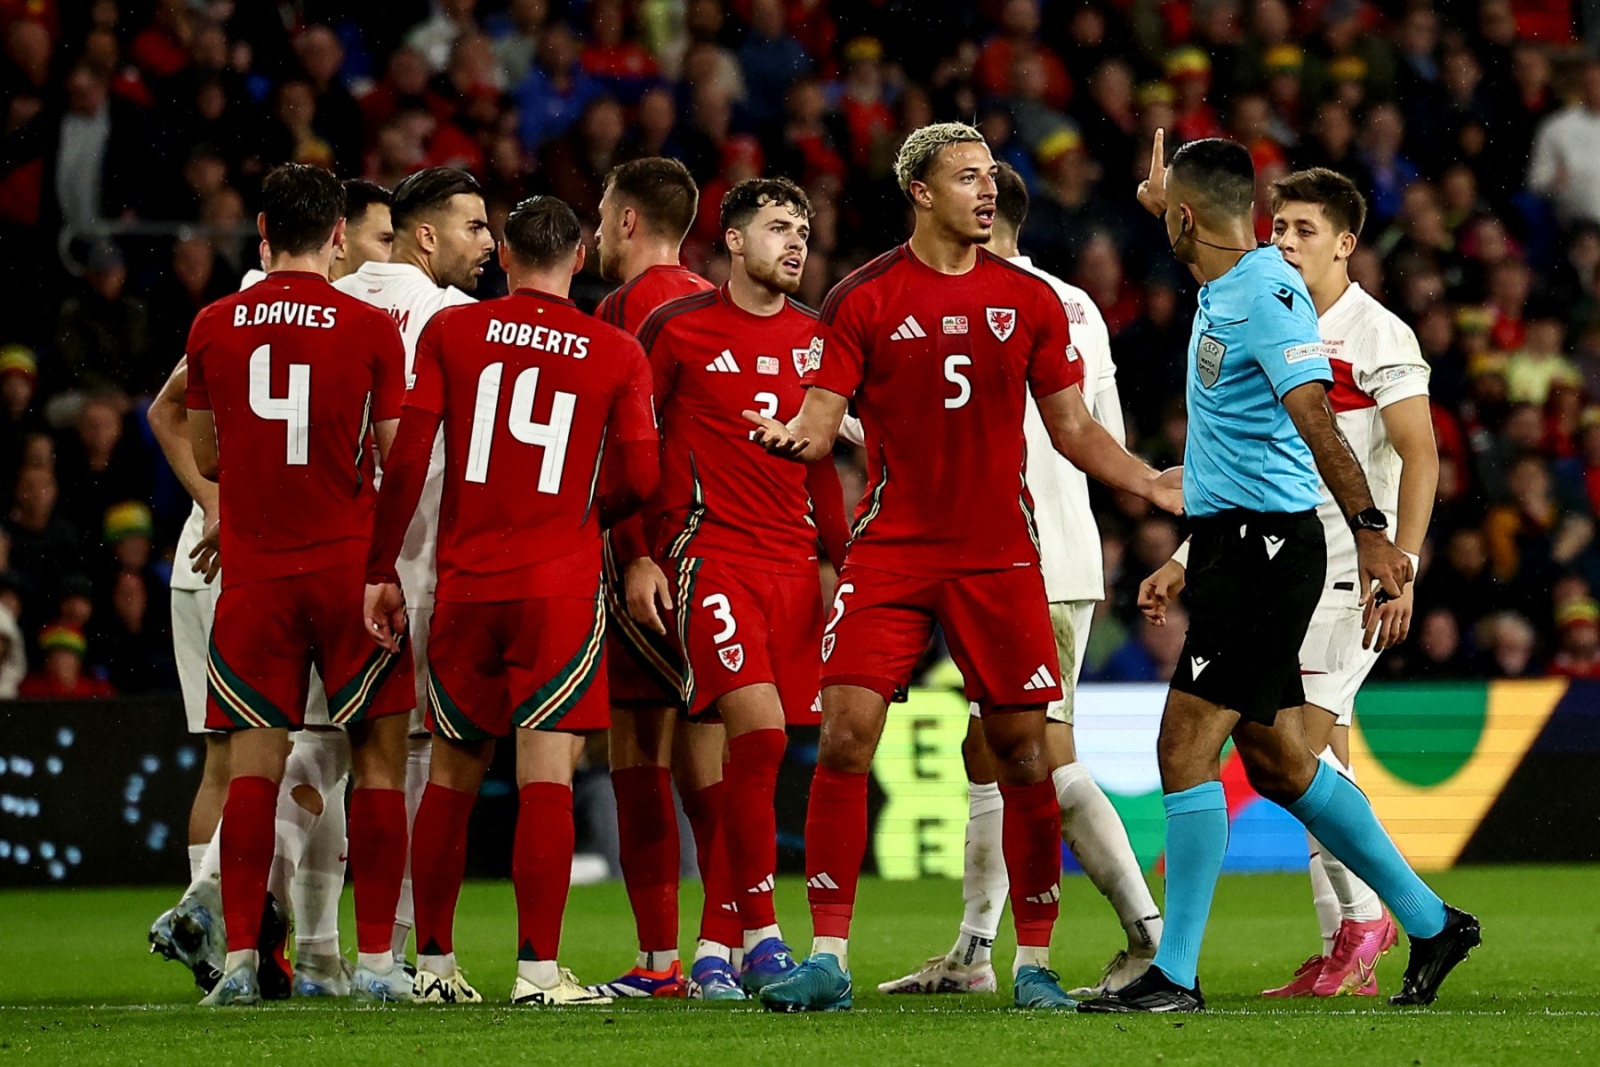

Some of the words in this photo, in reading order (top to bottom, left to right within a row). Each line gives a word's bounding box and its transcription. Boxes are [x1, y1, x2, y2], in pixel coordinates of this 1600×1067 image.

[233, 301, 337, 329] B.DAVIES
[485, 318, 590, 360] ROBERTS
[249, 344, 310, 465] 4
[944, 355, 972, 409] 5
[465, 362, 577, 495] 14
[702, 593, 736, 644] 3
[824, 583, 854, 634] 5
